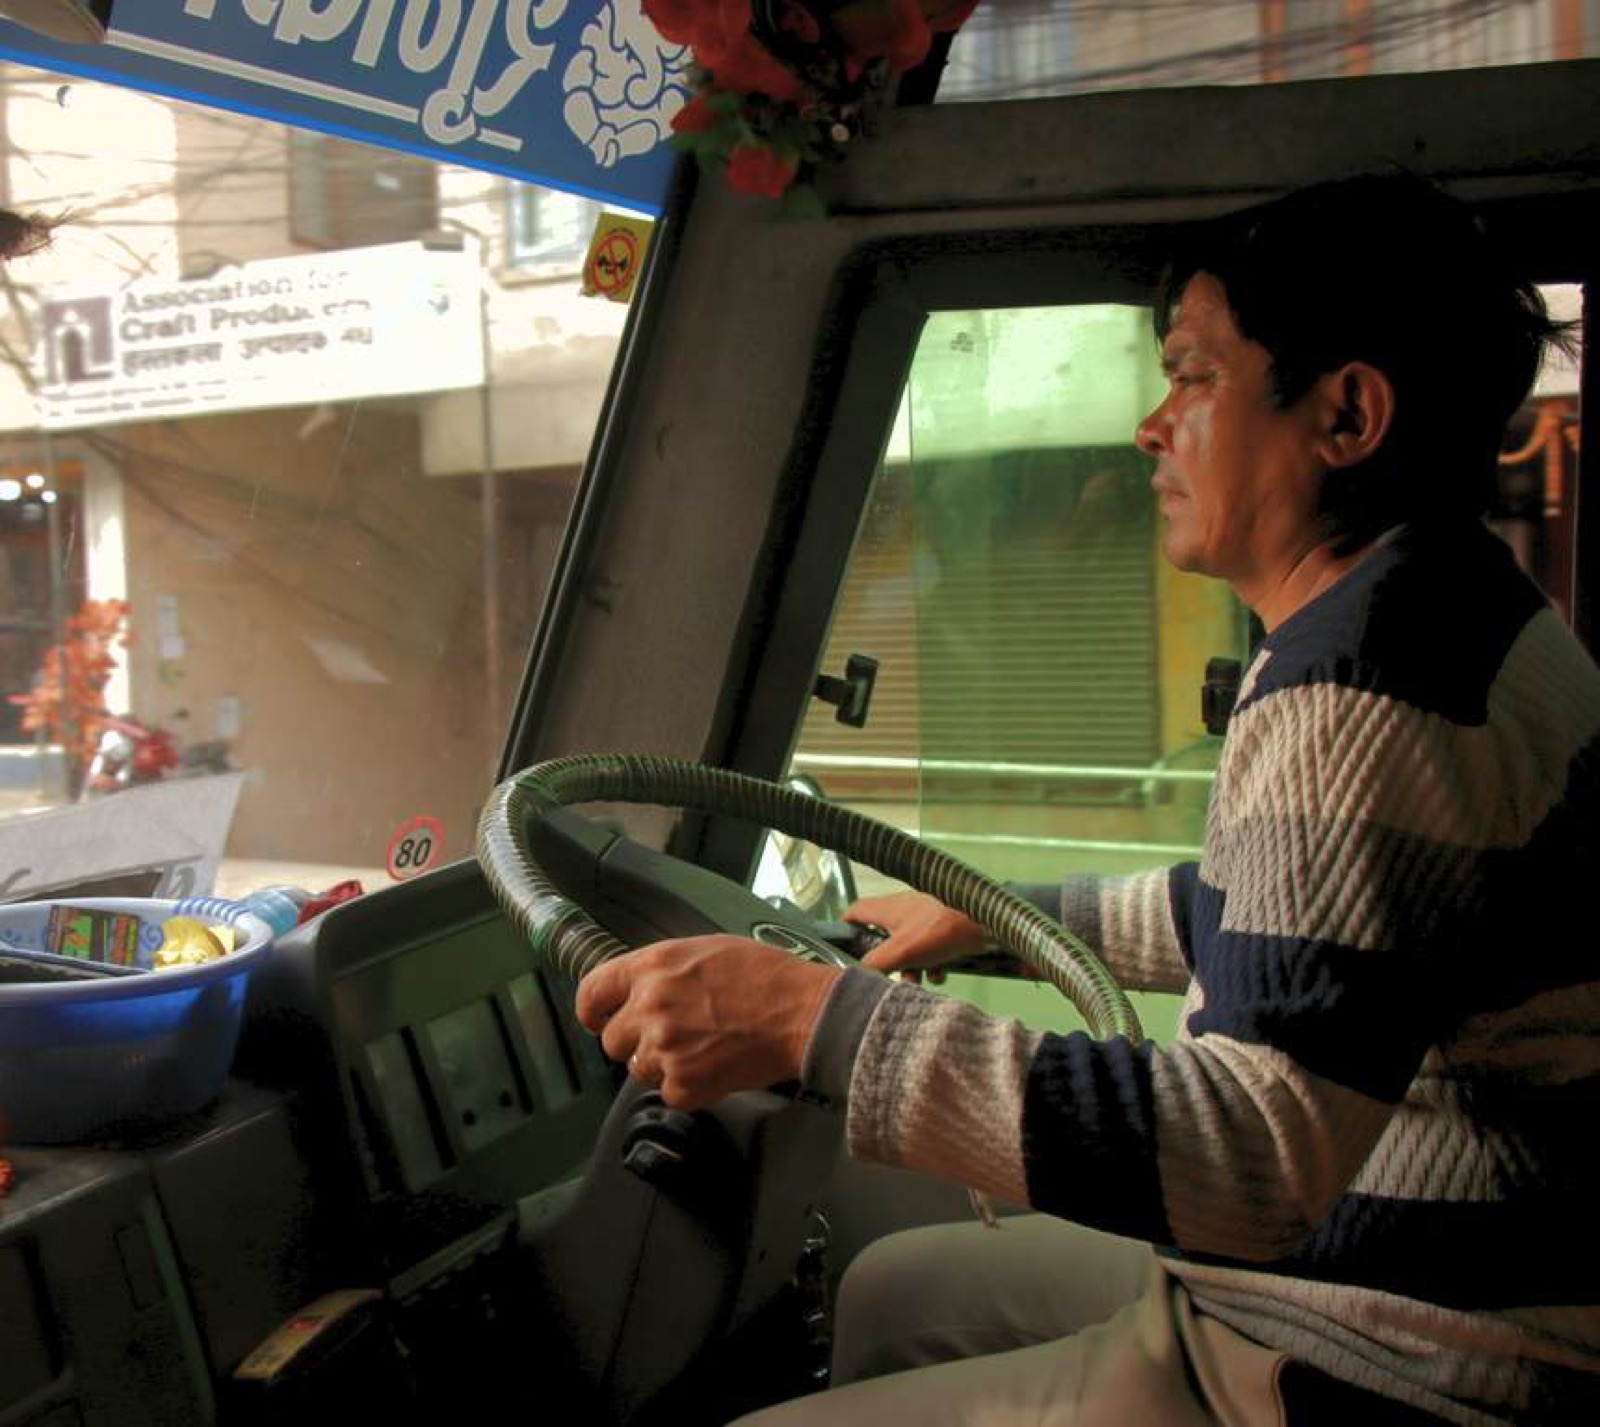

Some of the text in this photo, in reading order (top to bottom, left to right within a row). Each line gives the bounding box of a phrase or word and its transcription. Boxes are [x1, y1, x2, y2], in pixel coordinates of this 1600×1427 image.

[122, 277, 293, 314] Association
[119, 311, 196, 342] Craft
[395, 837, 432, 869] 80
